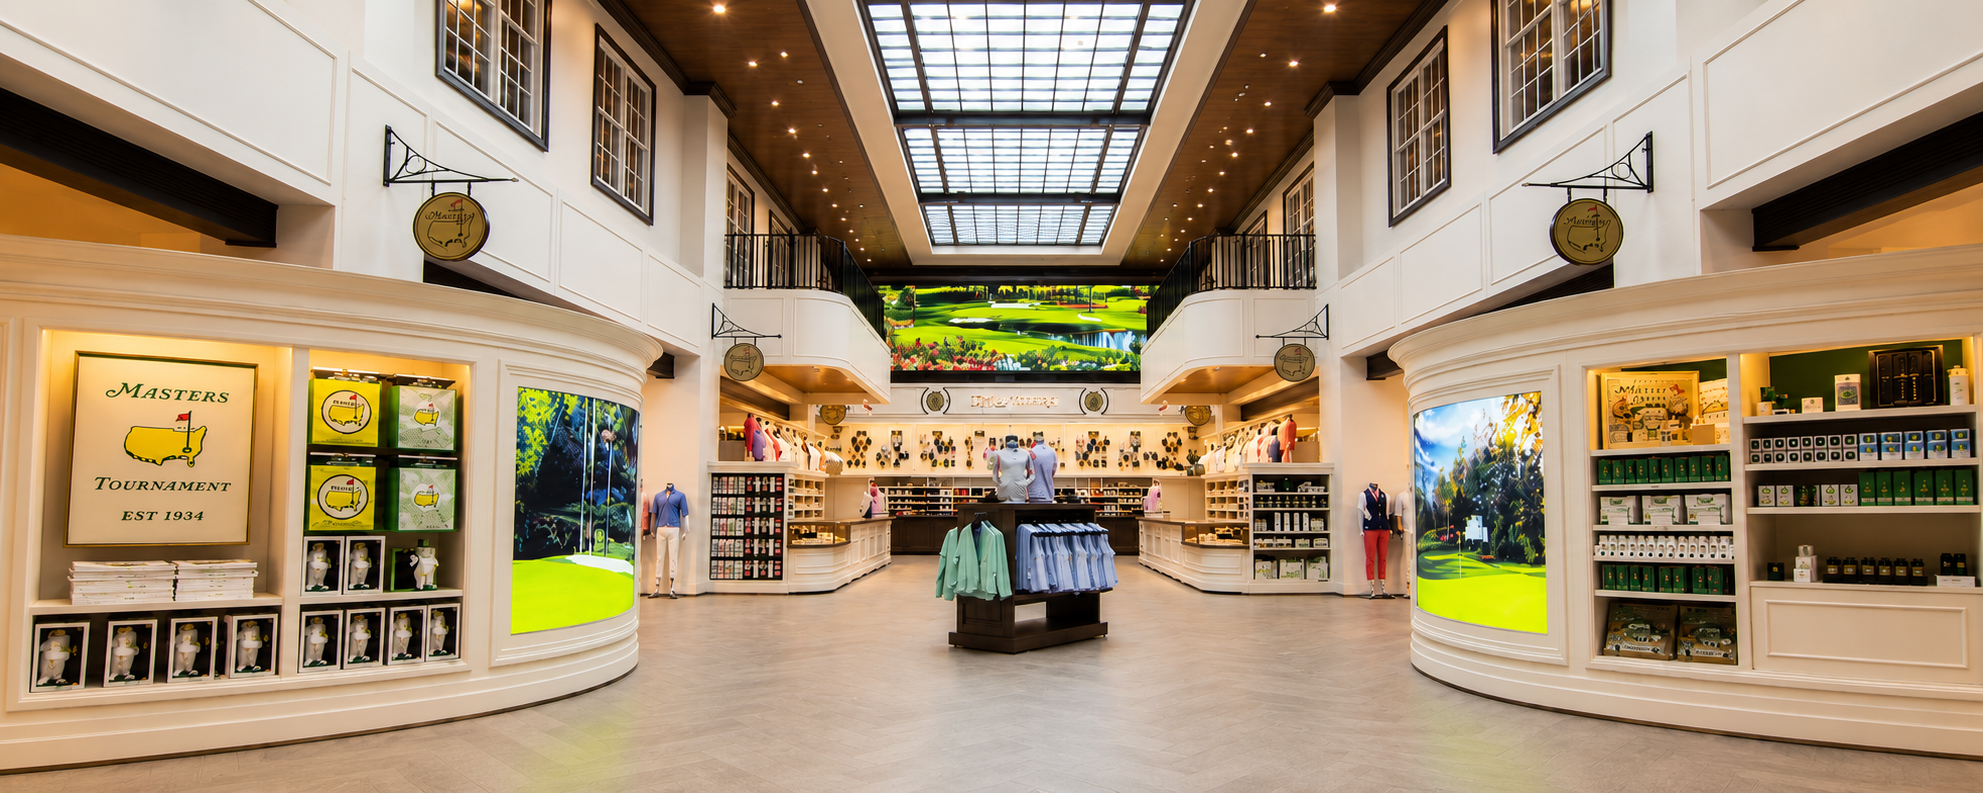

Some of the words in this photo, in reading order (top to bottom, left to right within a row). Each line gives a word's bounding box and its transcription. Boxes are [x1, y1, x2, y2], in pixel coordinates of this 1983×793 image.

[105, 382, 230, 404] MASTERS
[94, 476, 232, 492] TOURNAMENT
[121, 511, 158, 521] EST
[163, 511, 204, 521] 1934
